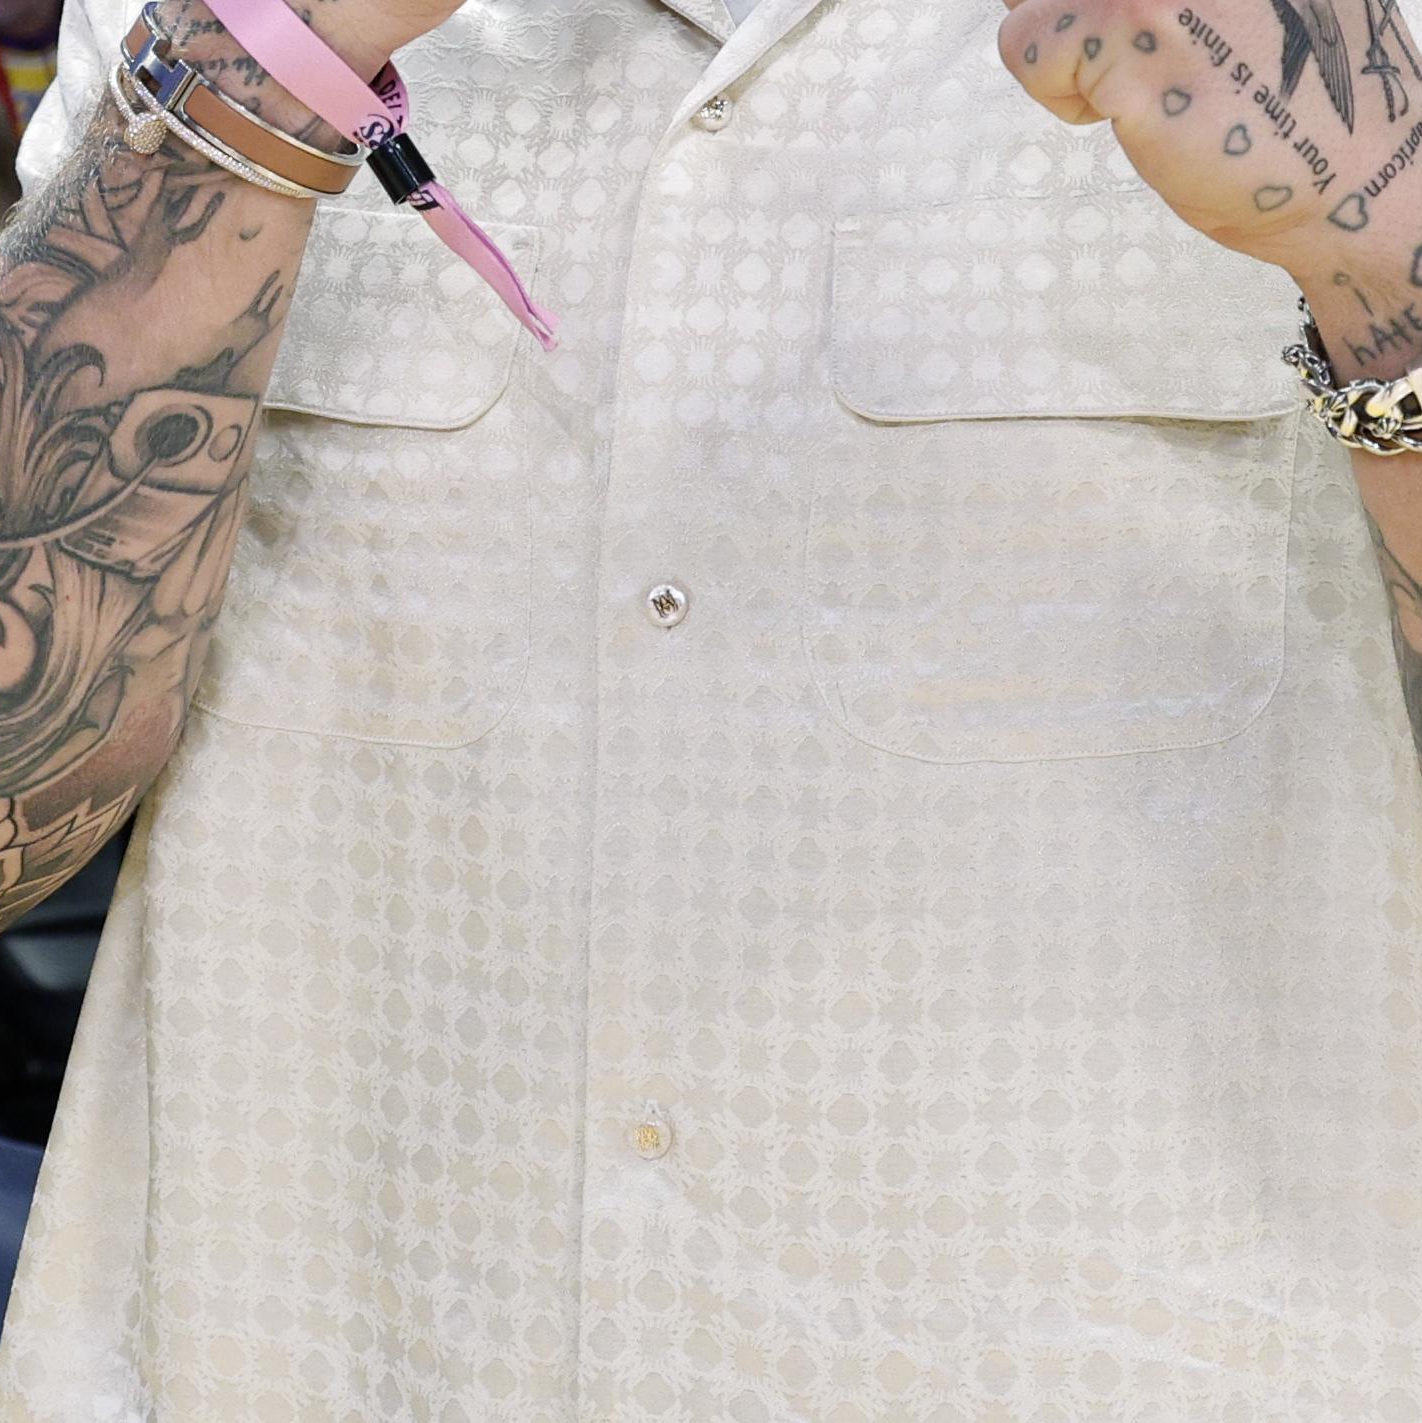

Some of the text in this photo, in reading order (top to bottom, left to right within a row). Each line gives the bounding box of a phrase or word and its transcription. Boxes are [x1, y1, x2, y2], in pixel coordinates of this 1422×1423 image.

[1177, 7, 1337, 195] Your time is finite
